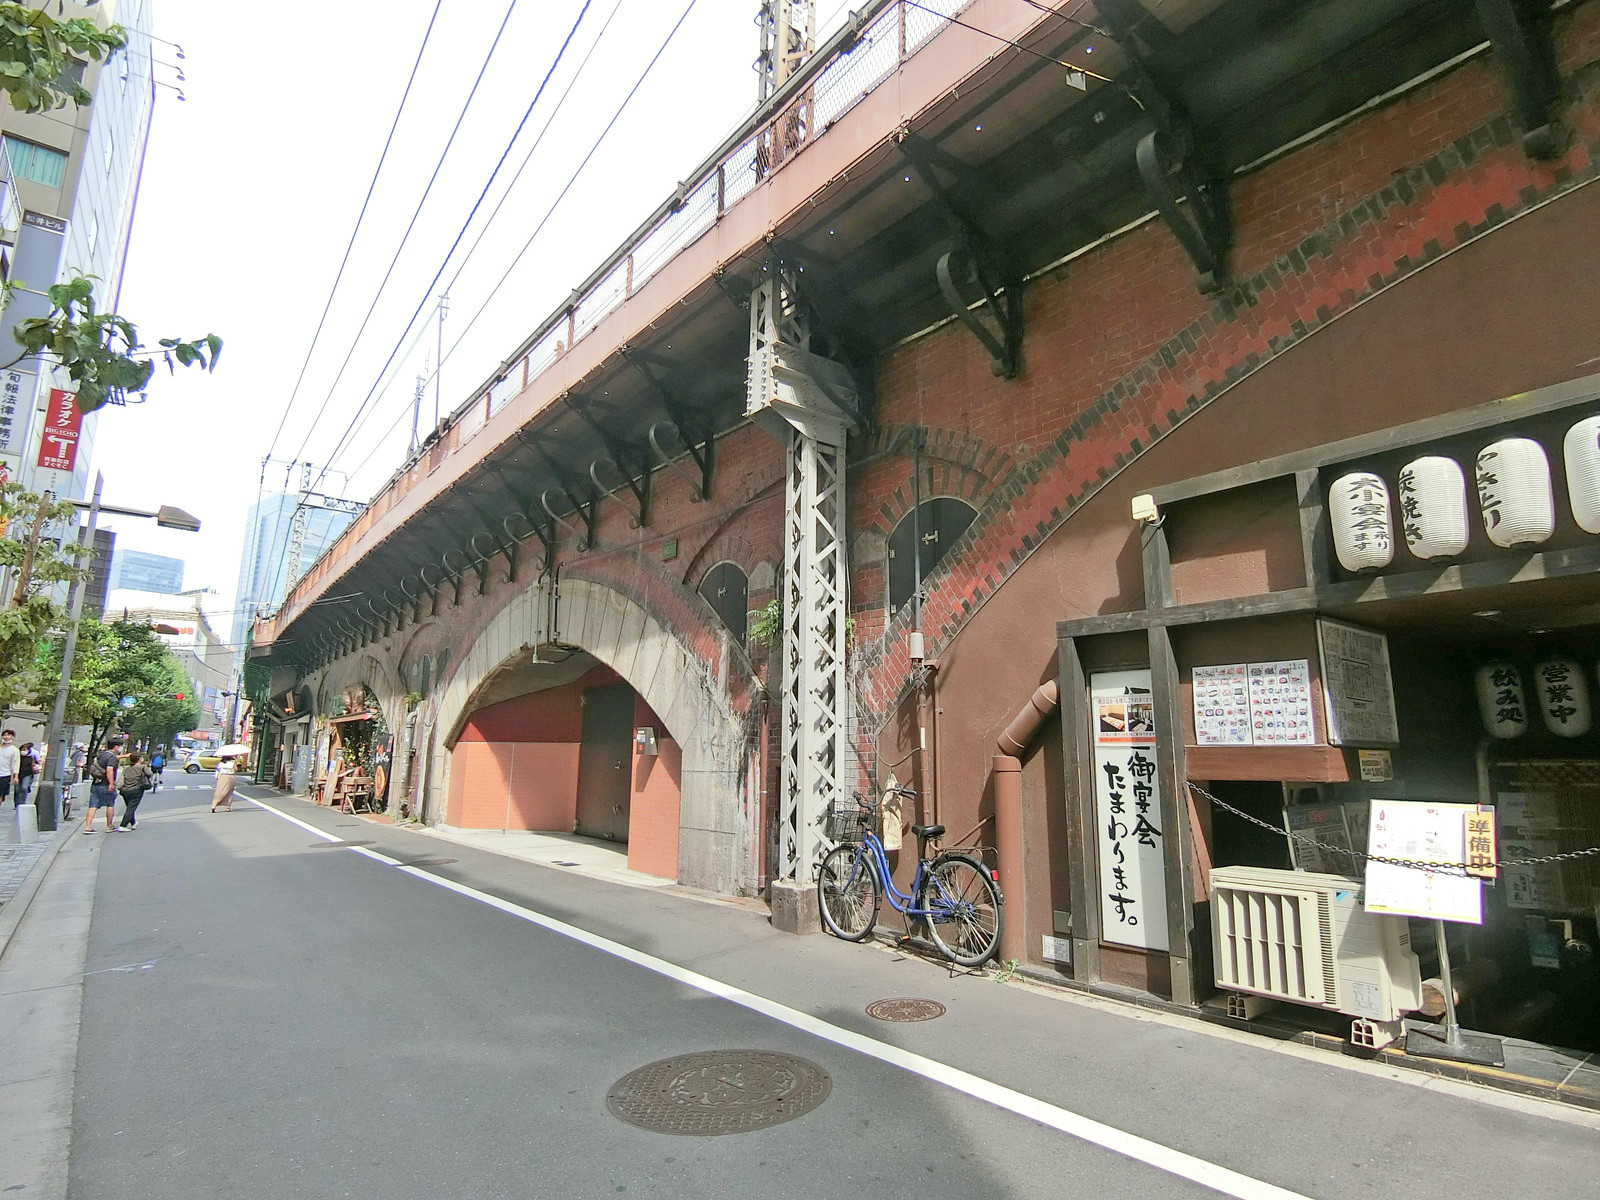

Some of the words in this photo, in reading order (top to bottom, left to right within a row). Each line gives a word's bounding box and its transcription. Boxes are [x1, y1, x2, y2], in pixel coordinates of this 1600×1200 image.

[26, 214, 64, 230] 松井ビル
[57, 392, 76, 427] カラオケ
[1398, 470, 1423, 546] 炭焼き
[1476, 452, 1503, 529] やきとり
[1488, 668, 1525, 724] 飲み処
[1542, 663, 1577, 724] 営業中
[1103, 761, 1138, 926] たまわります。
[1468, 820, 1493, 871] 準備中
